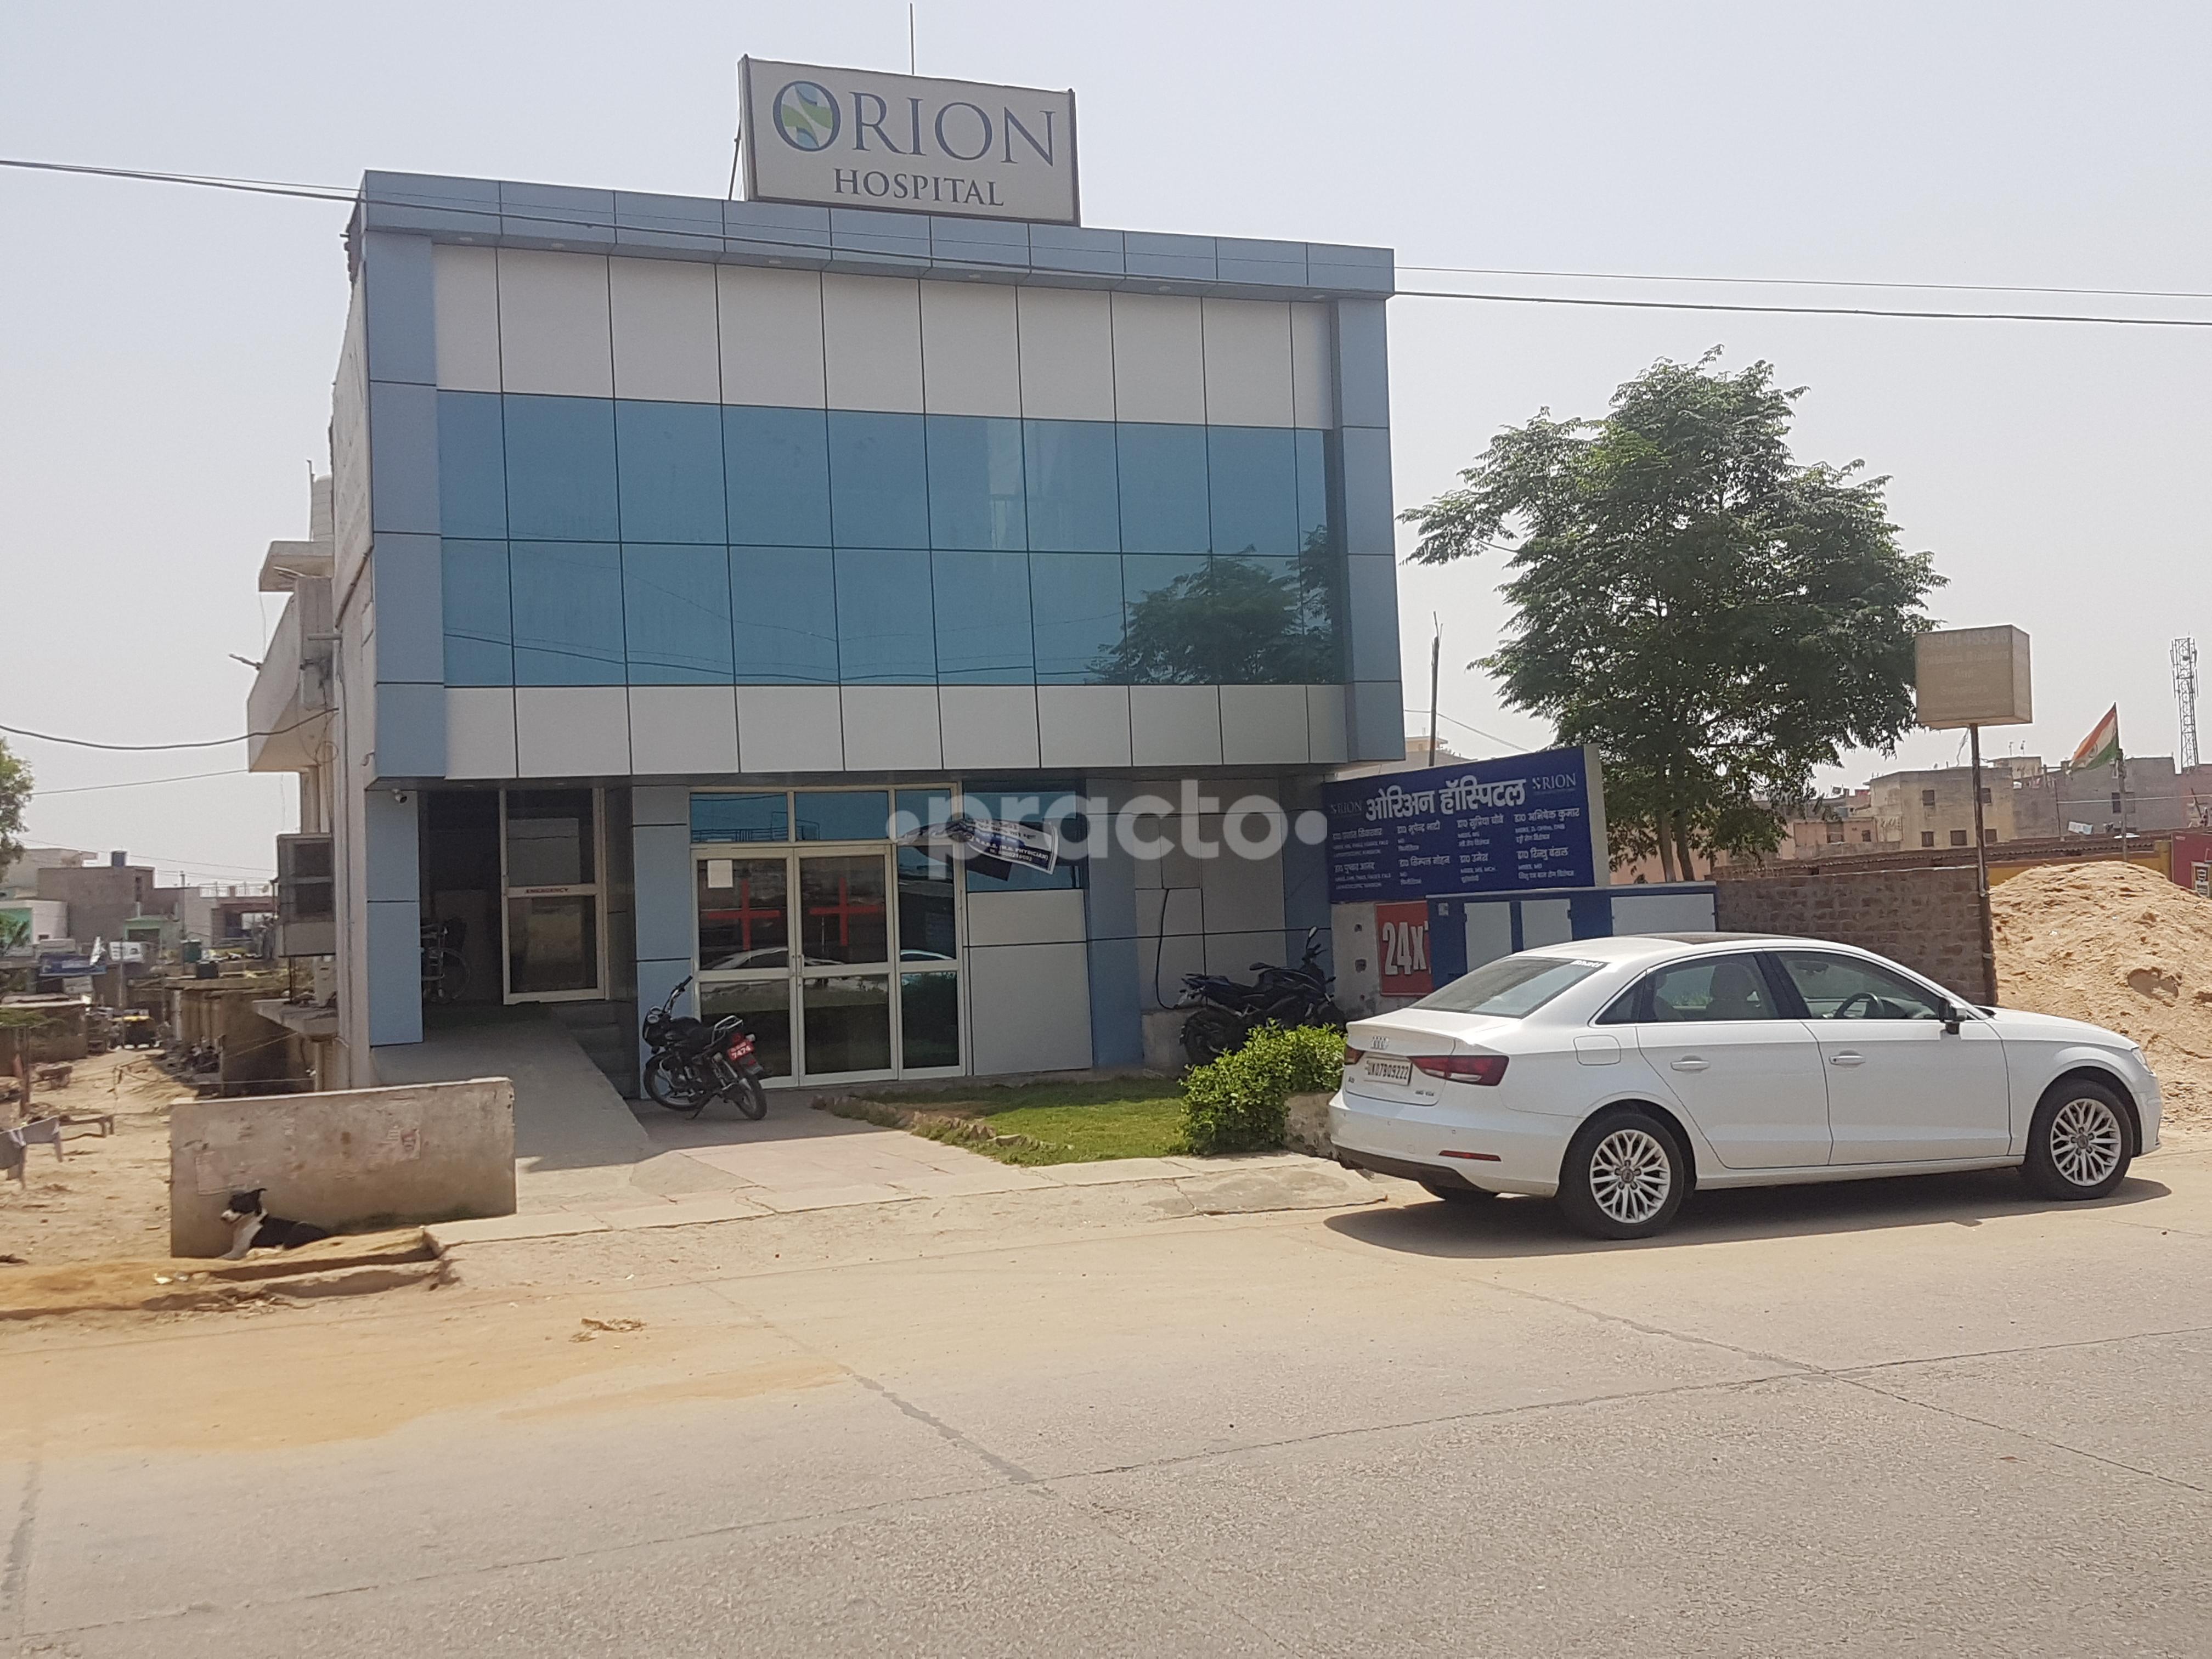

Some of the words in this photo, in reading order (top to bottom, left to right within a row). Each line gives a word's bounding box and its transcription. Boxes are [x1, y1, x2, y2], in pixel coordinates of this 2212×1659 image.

[773, 81, 1056, 166] ORION
[834, 168, 1004, 207] HOSPITAL
[1440, 775, 1527, 815] हॉस्पिटल
[1383, 921, 1431, 975] 24X
